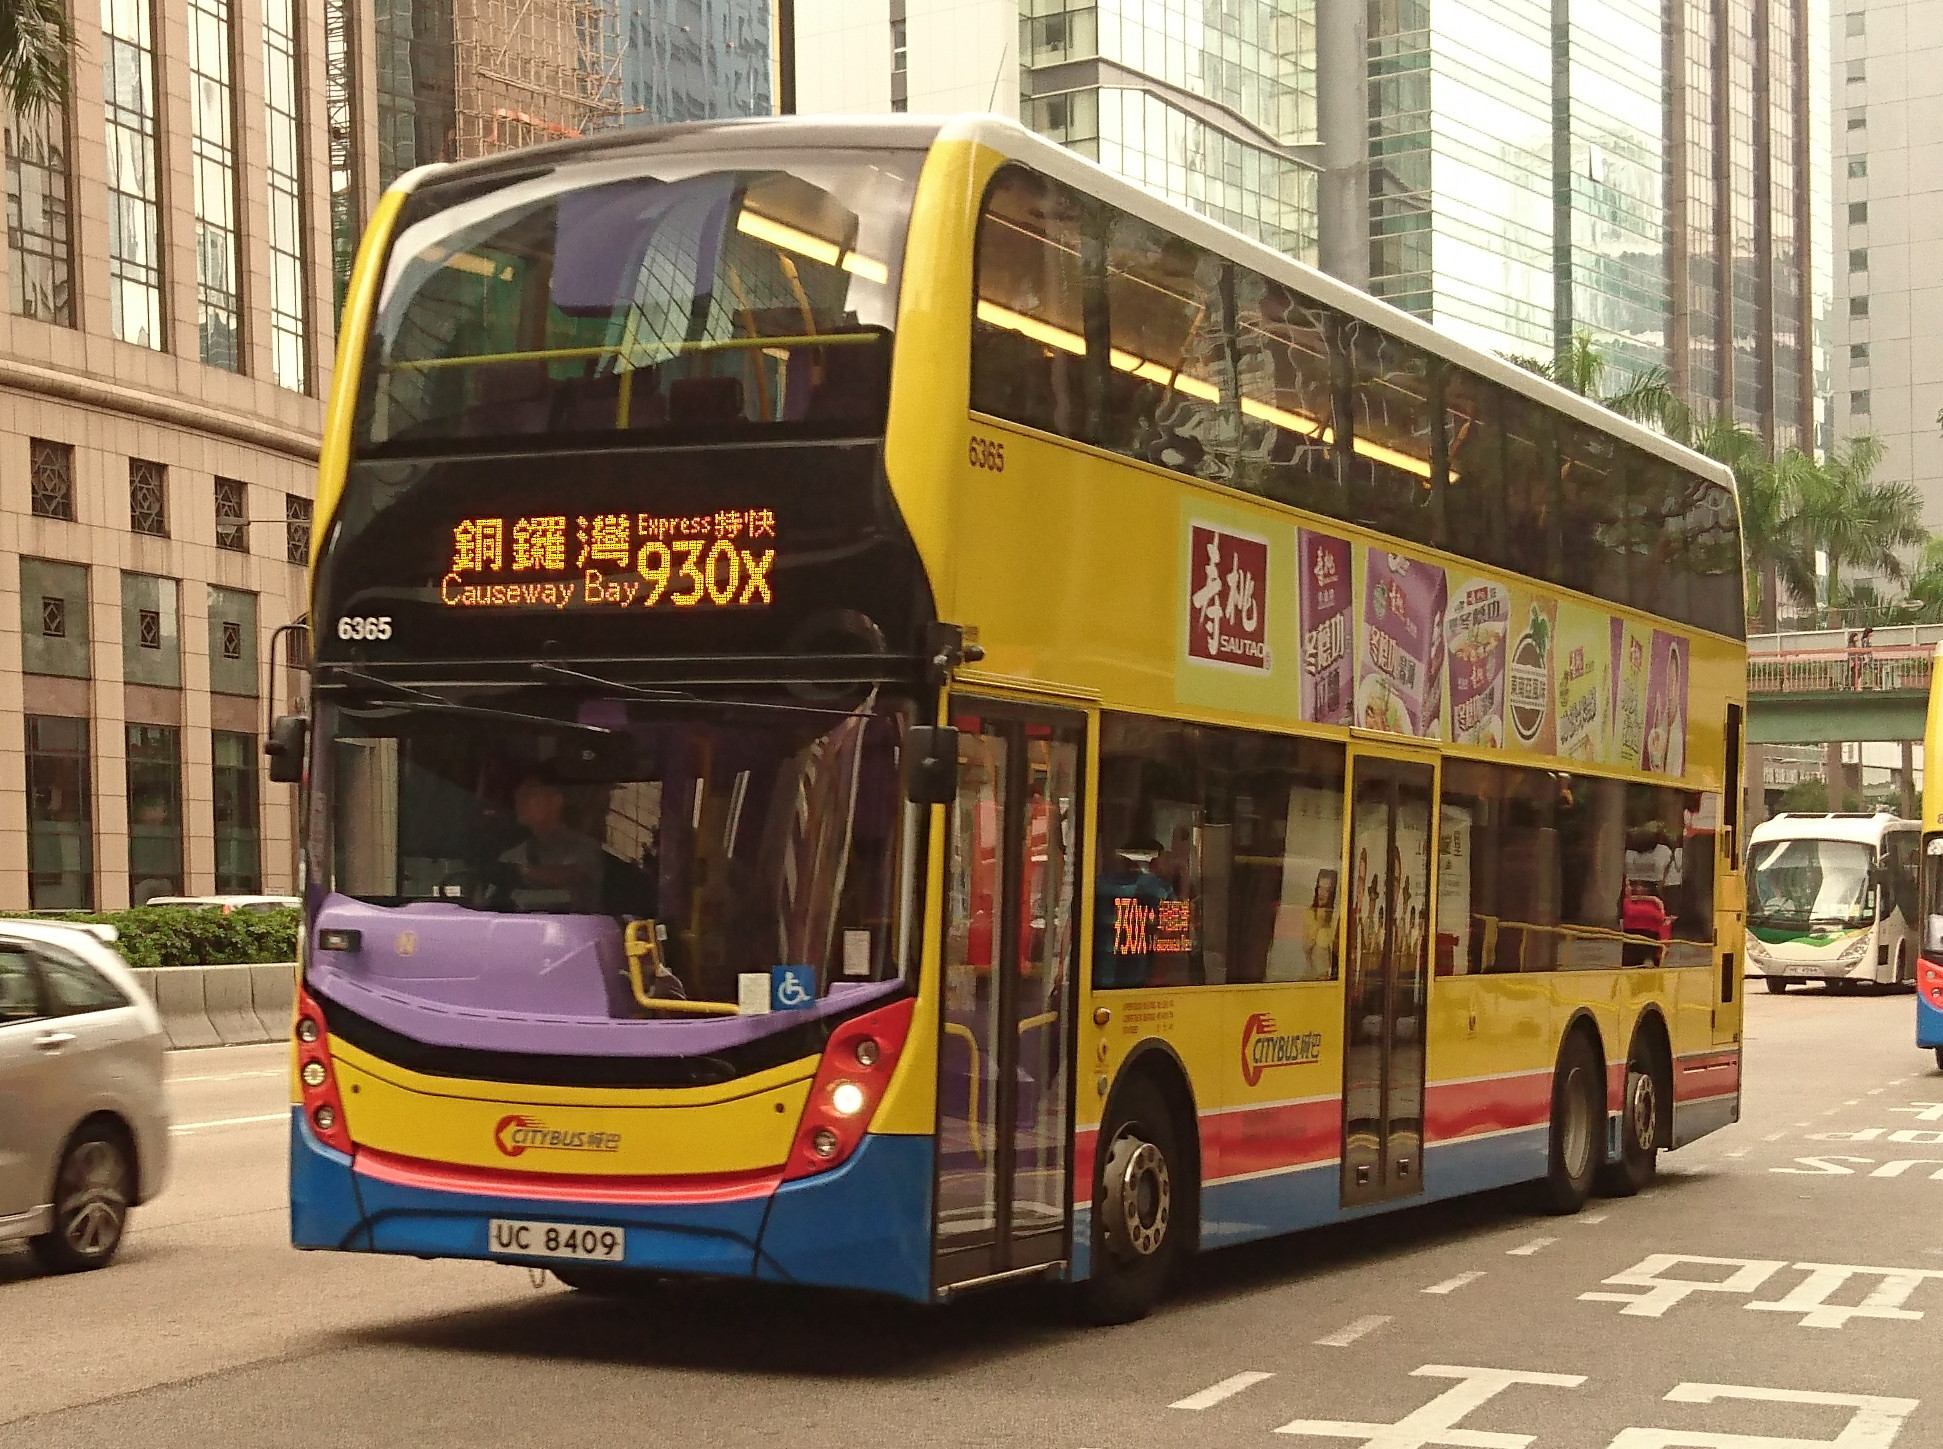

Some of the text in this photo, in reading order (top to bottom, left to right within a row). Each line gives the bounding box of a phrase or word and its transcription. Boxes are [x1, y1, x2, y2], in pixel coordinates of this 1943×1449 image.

[968, 435, 1005, 473] 6365
[637, 508, 776, 540] Express 特快
[452, 513, 632, 573] 銅鑼灣
[441, 569, 640, 609] Causeway Bay
[337, 616, 393, 641] 6365
[1219, 634, 1265, 658] SAUTAO
[1252, 1034, 1300, 1063] CITYBUS
[511, 1128, 586, 1147] CITYBUS
[1769, 1155, 1943, 1181] US
[496, 1223, 617, 1256] UC 8409
